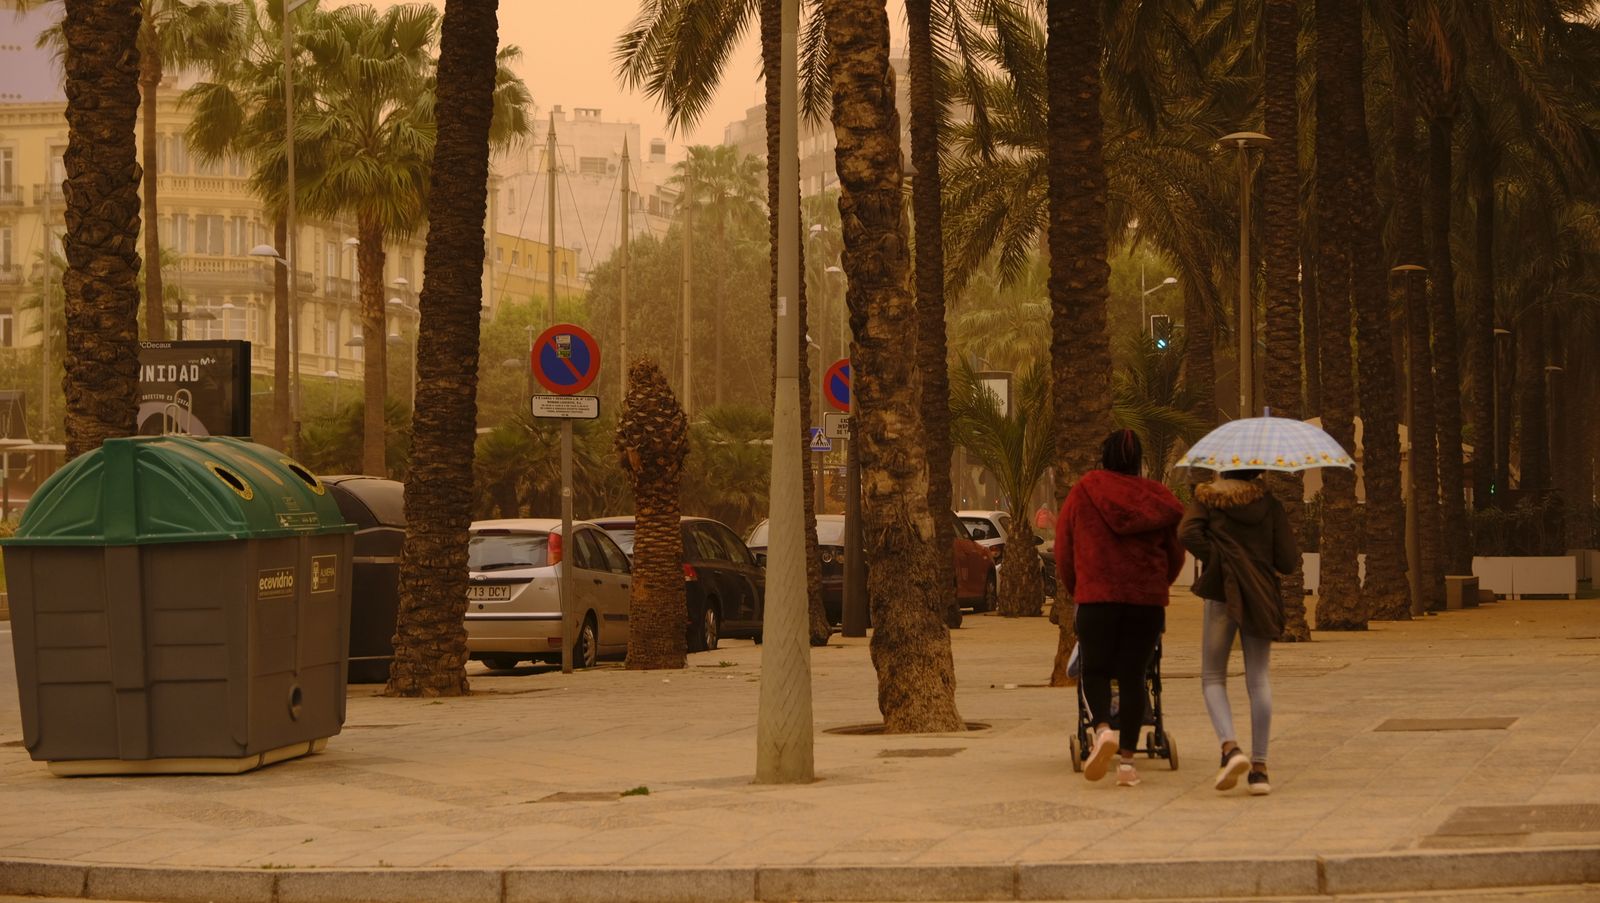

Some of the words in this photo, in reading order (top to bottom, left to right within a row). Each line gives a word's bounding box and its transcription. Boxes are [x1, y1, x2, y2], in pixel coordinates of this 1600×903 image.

[139, 341, 172, 349] CDecaux
[259, 571, 294, 591] ecovidrio
[488, 586, 507, 597] DCY
